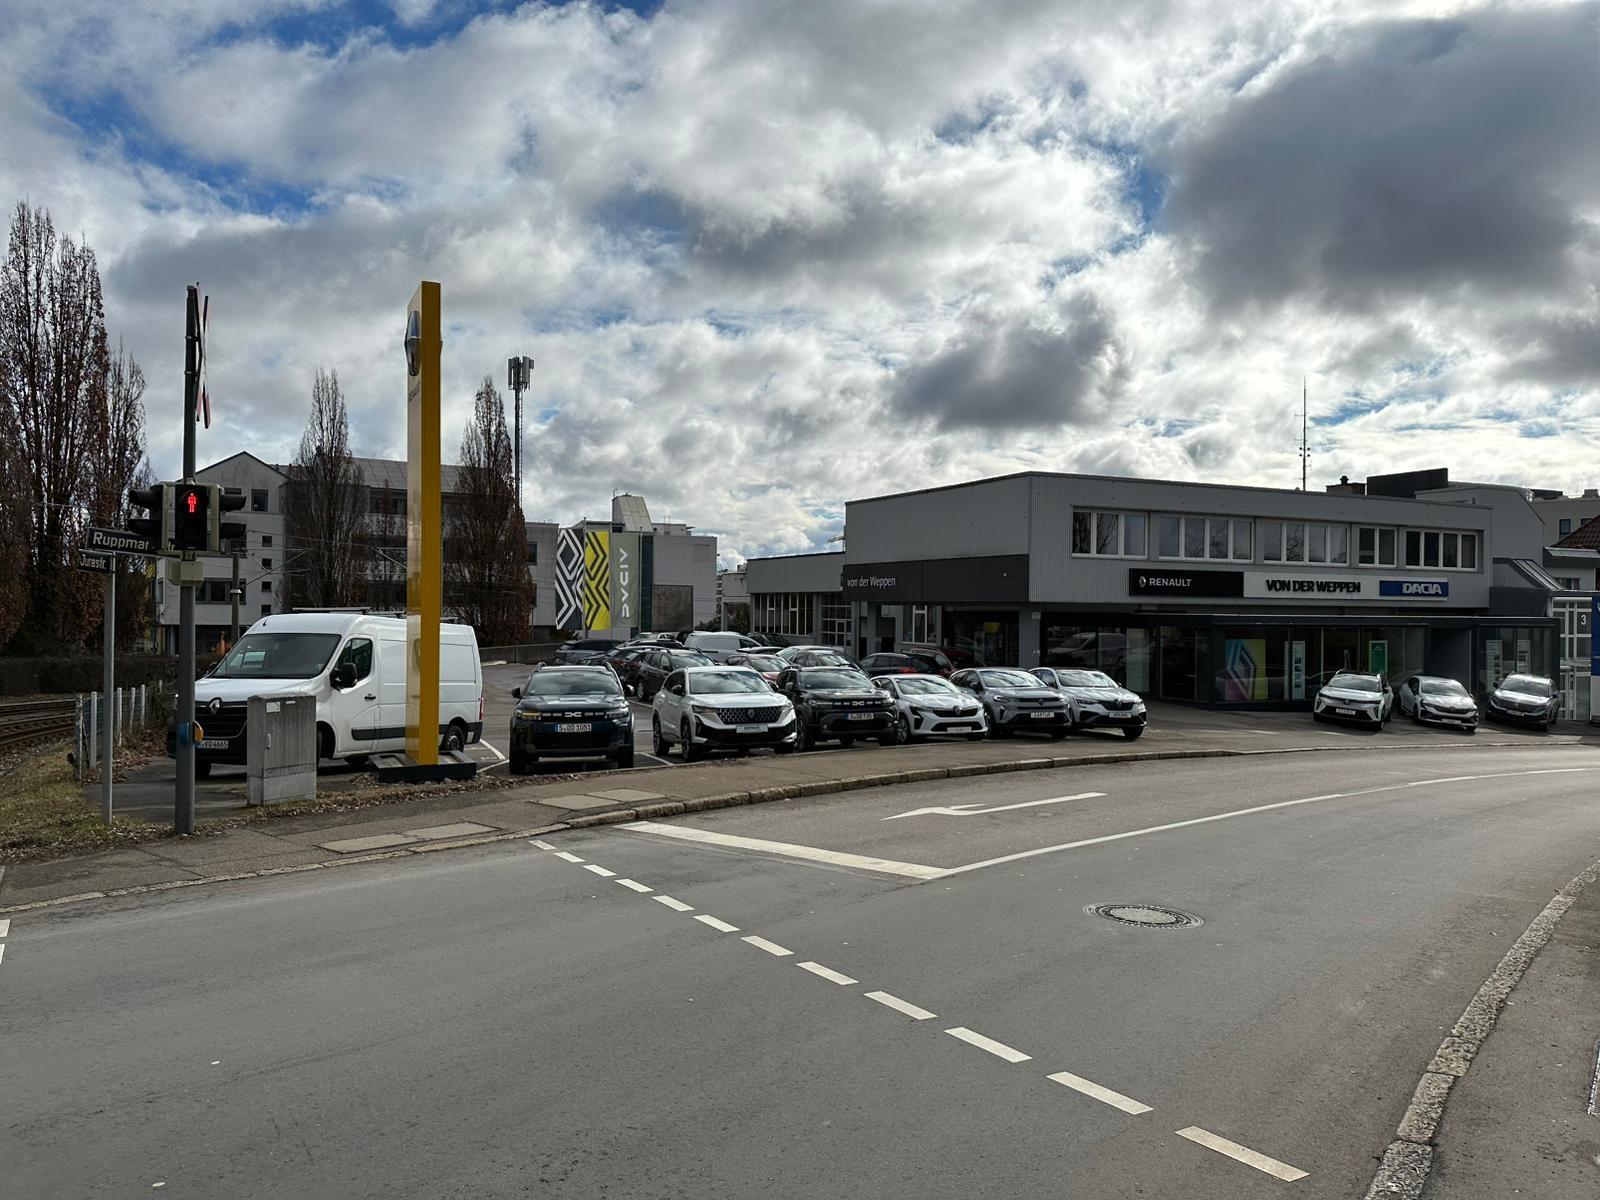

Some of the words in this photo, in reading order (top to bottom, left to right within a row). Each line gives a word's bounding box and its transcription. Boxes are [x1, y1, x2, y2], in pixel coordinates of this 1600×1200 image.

[80, 553, 107, 570] Jurastr.
[847, 579, 859, 587] von
[859, 575, 869, 587] der
[870, 576, 896, 590] Weppen
[1149, 577, 1192, 587] RENAULT
[1266, 579, 1291, 592] VON
[1292, 580, 1315, 593] DER
[1316, 581, 1361, 594] WEPPEN
[1402, 582, 1442, 595] DACIA
[1580, 614, 1587, 625] 3
